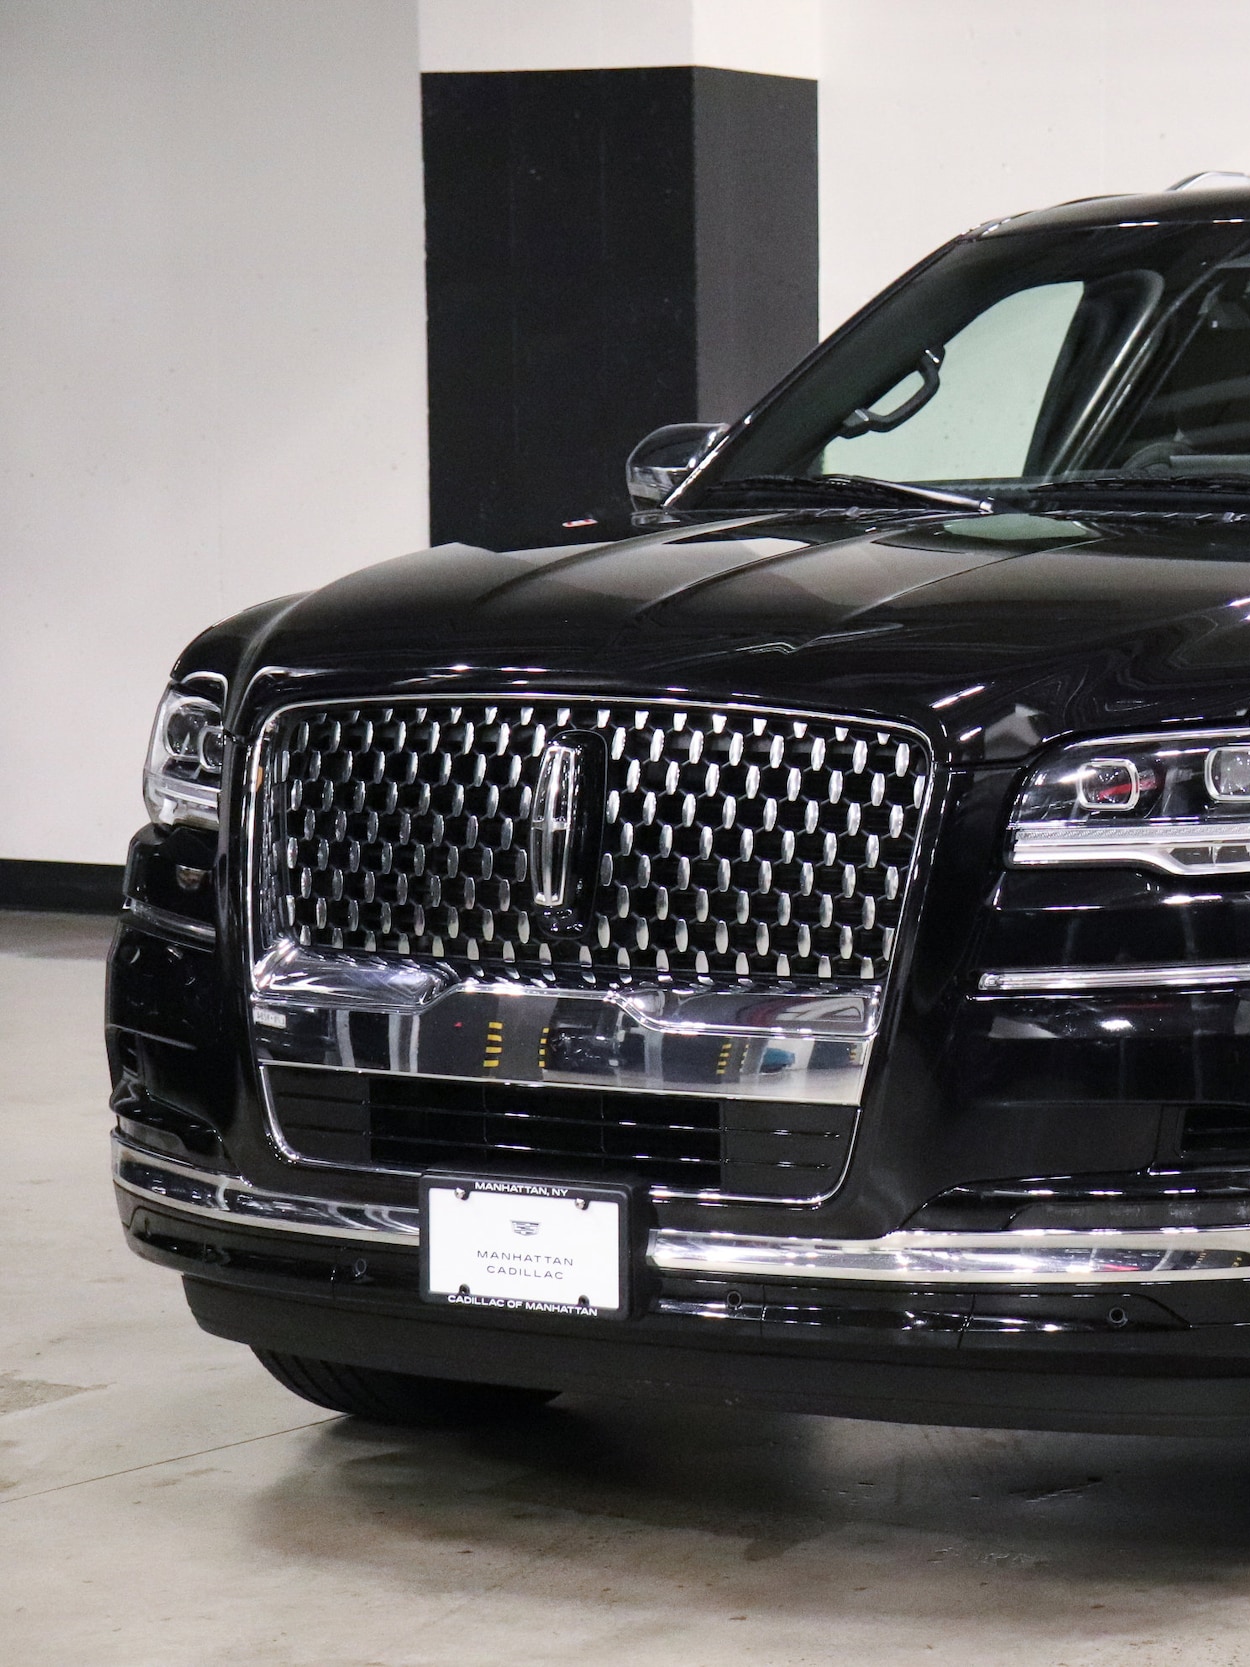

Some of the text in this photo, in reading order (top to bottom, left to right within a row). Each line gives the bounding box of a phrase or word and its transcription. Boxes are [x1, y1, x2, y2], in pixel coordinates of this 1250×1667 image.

[474, 1181, 568, 1198] MANHATTAN, NY
[477, 1250, 573, 1266] MANHATTAN
[486, 1265, 564, 1279] CADILLAC
[447, 1294, 598, 1317] CADILLAC OF MANHATTAN
